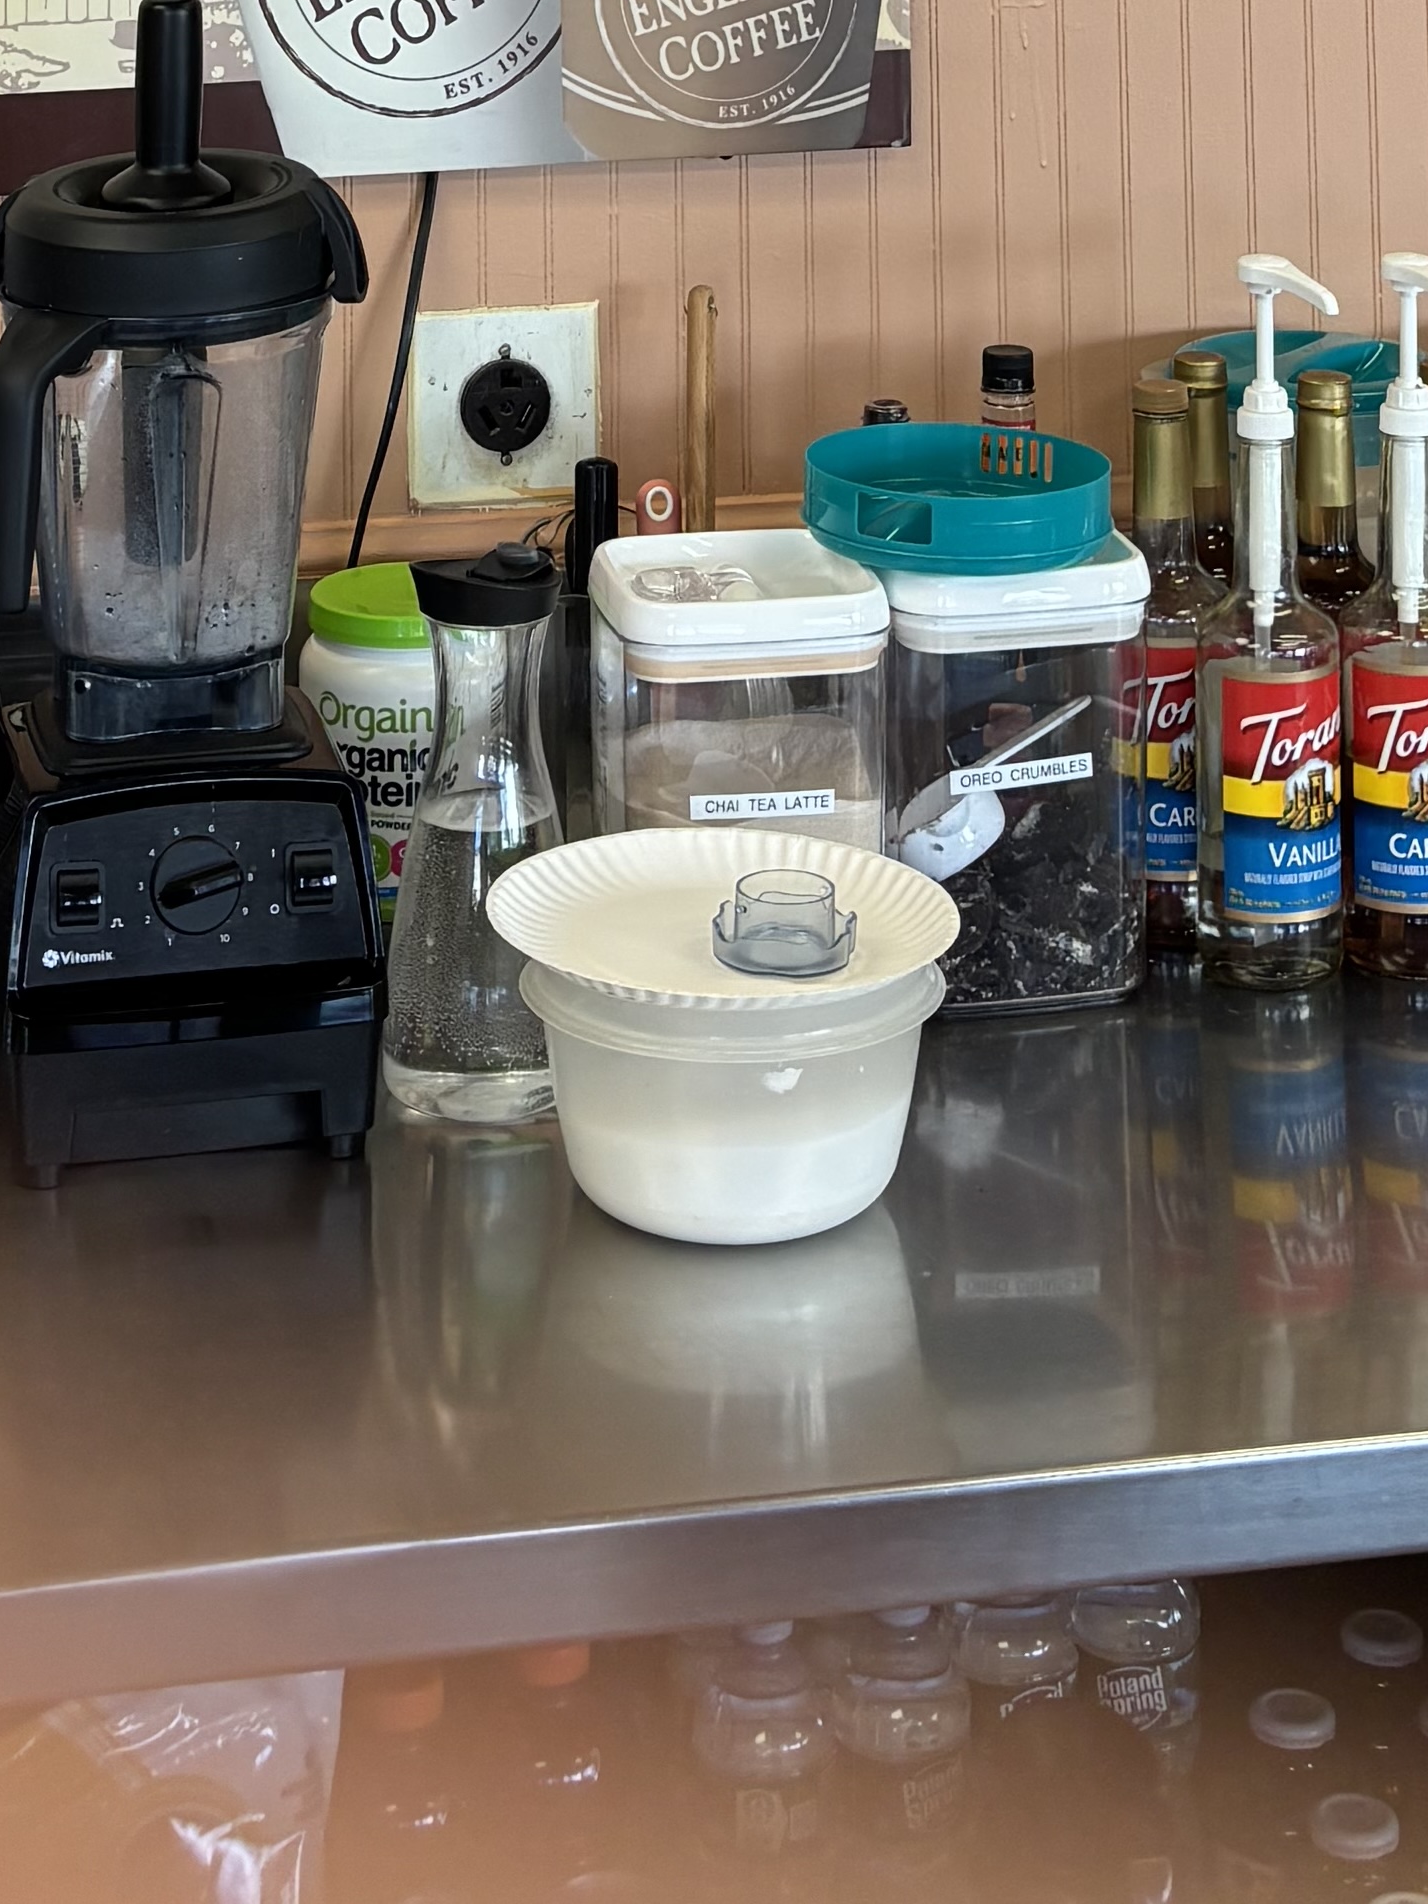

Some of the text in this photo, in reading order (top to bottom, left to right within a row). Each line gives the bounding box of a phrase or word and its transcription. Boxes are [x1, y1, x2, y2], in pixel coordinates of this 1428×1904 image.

[443, 30, 539, 100] EST. 1916
[657, 0, 820, 81] COFFEE
[319, 691, 434, 742] Orgain
[1241, 701, 1340, 785] Toran
[960, 760, 1088, 790] OREO CRUMBLES
[705, 795, 830, 815] CHAI TEA LATTE
[60, 950, 113, 965] Vitamix
